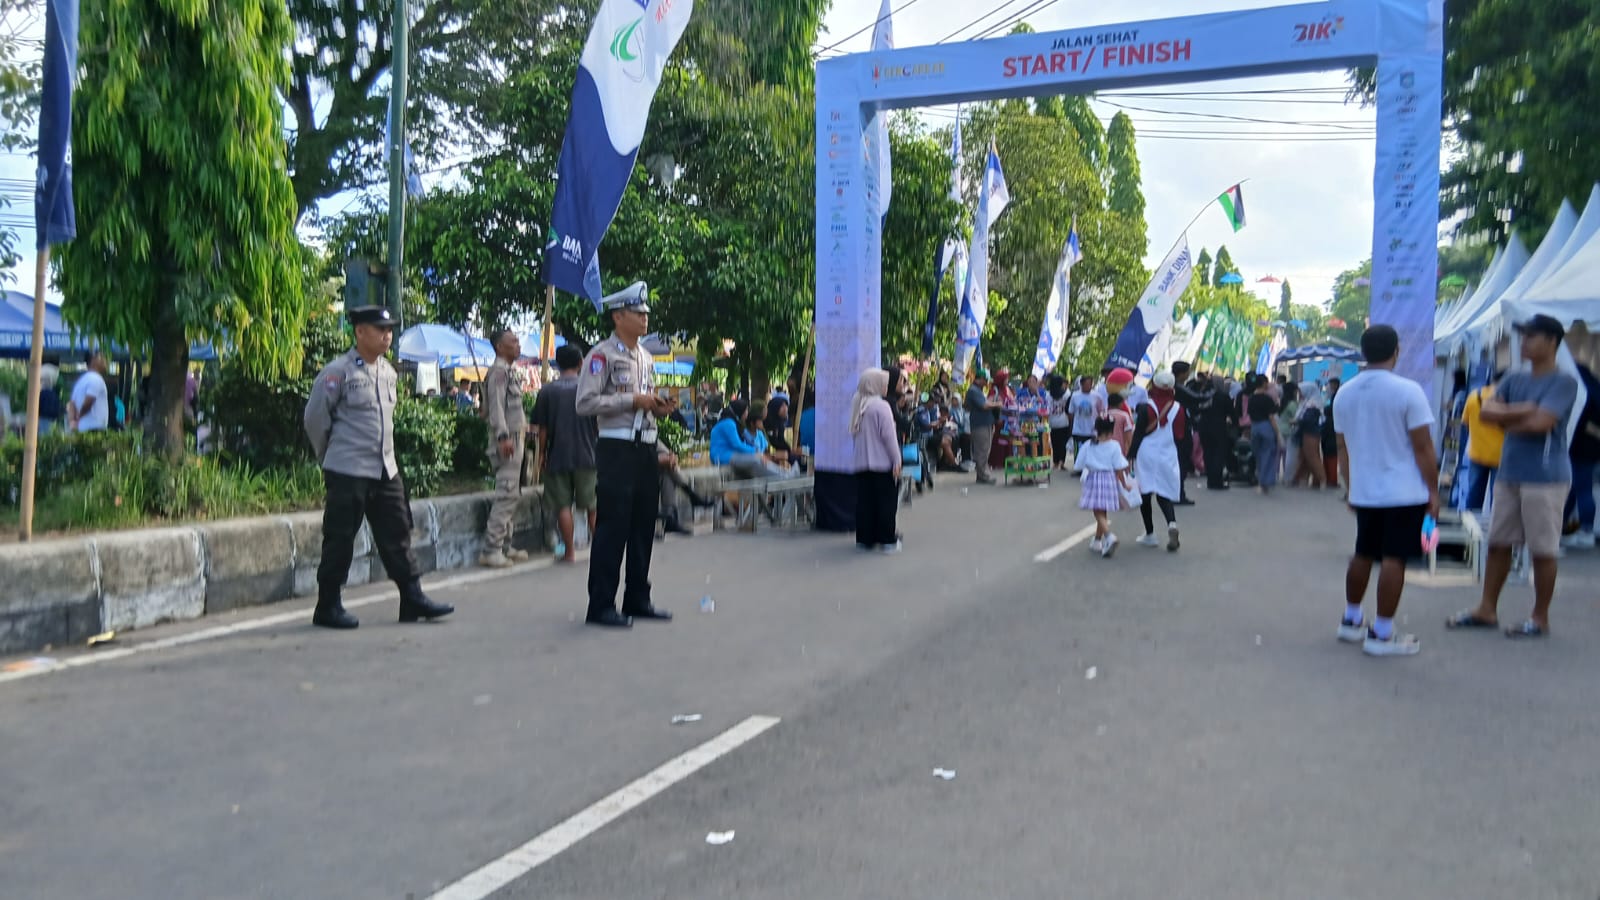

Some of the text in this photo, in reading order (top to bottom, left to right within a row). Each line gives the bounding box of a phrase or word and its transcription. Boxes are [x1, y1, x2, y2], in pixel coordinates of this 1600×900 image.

[1051, 30, 1139, 50] JALAN SEHAT
[1103, 39, 1191, 69] FINISH
